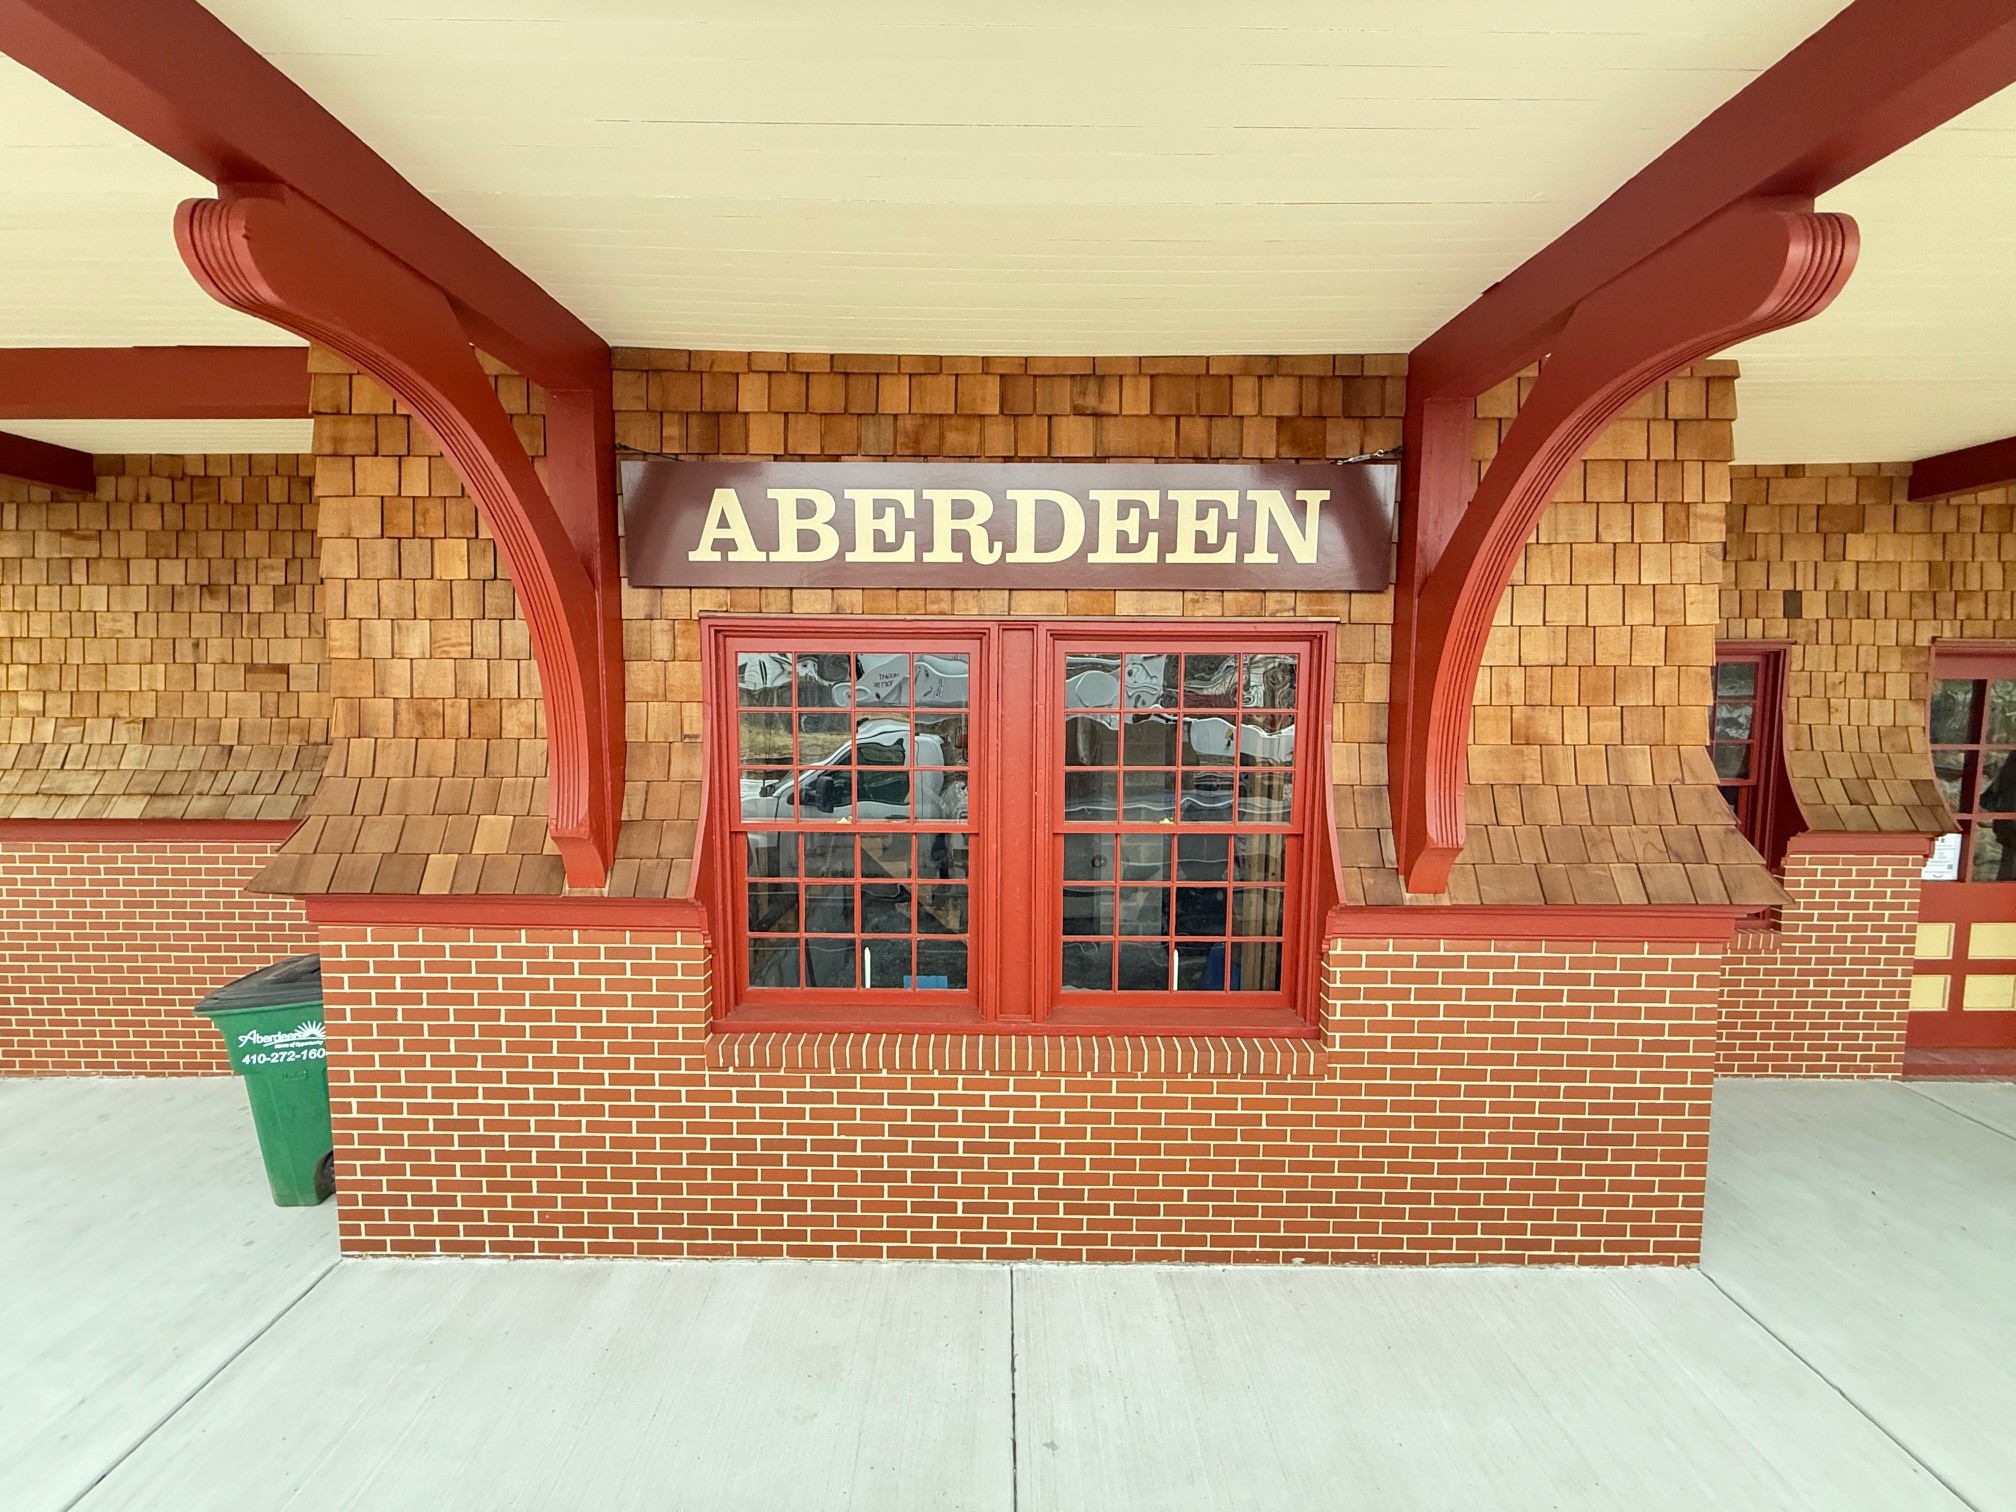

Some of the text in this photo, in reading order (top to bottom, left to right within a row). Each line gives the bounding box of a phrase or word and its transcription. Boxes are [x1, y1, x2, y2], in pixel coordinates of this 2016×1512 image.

[688, 488, 1331, 565] ABERDEEN
[238, 1029, 302, 1047] Aberdeen
[242, 1047, 327, 1065] 410-272-160
